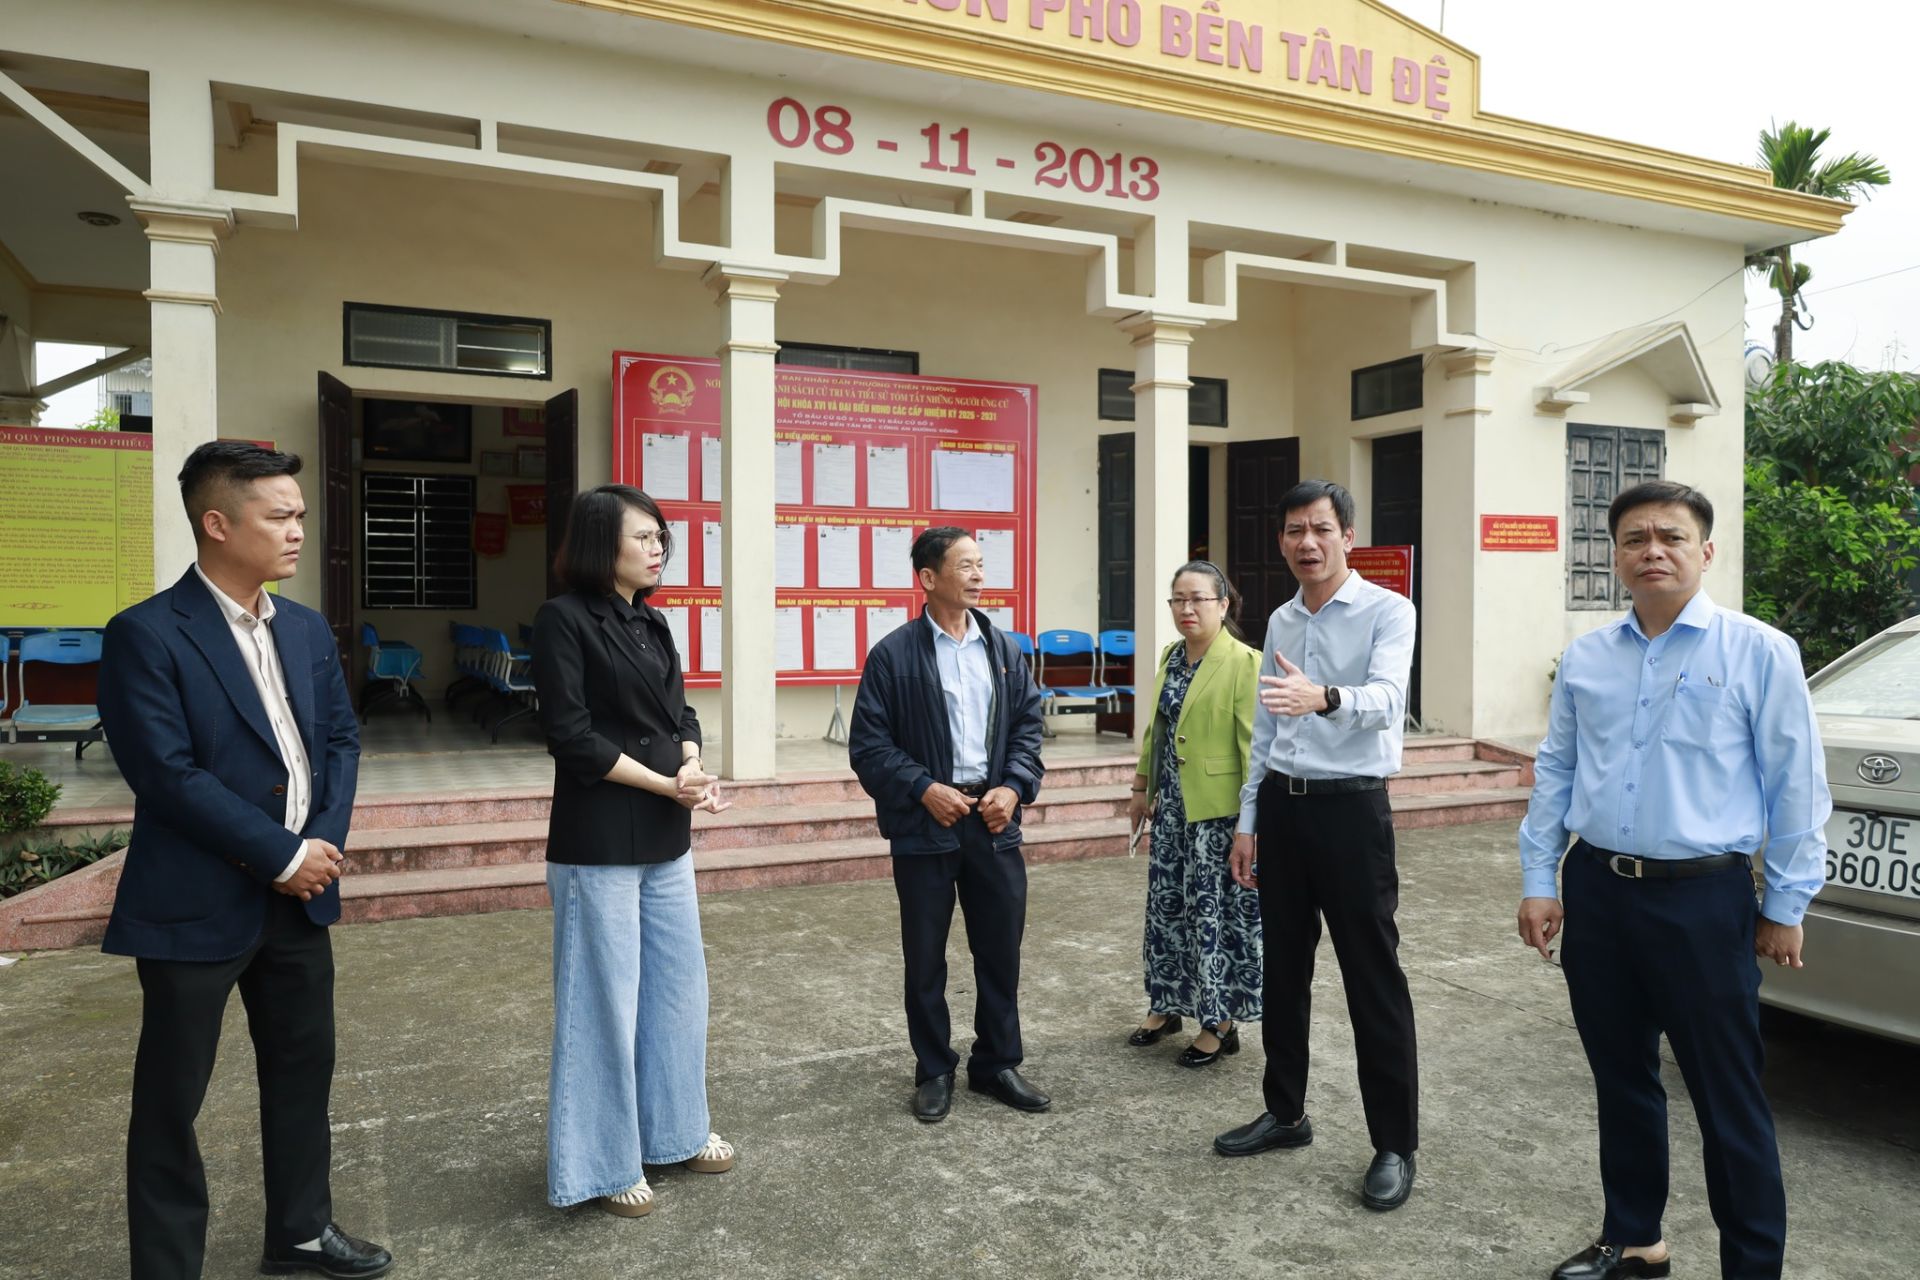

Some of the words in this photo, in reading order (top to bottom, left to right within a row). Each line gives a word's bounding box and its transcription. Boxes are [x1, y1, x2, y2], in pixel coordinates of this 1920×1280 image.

[1280, 27, 1373, 95] TÂN
[1391, 54, 1450, 121] ĐỆ
[767, 97, 853, 155] 08
[877, 139, 898, 152] -
[920, 122, 976, 176] 11
[996, 157, 1015, 168] -
[1034, 142, 1159, 201] 2013
[775, 385, 790, 393] ANH
[792, 384, 814, 395] SÁCH
[816, 385, 829, 396] CỬ
[830, 388, 843, 397] TRI
[845, 387, 857, 398] VÀ
[777, 397, 790, 409] HỘI
[814, 400, 825, 410] XVI
[828, 399, 837, 410] VÀ
[839, 401, 851, 412] ĐẠI
[892, 404, 906, 415] CÁC
[908, 403, 922, 416] CẤP
[14, 433, 39, 442] QUY
[44, 434, 87, 444] PHÒNG
[90, 436, 107, 445] BỎ
[683, 596, 693, 605] CỬ
[695, 597, 711, 605] VIÊN
[712, 598, 721, 606] ĐẠ
[1846, 816, 1910, 855] 30E
